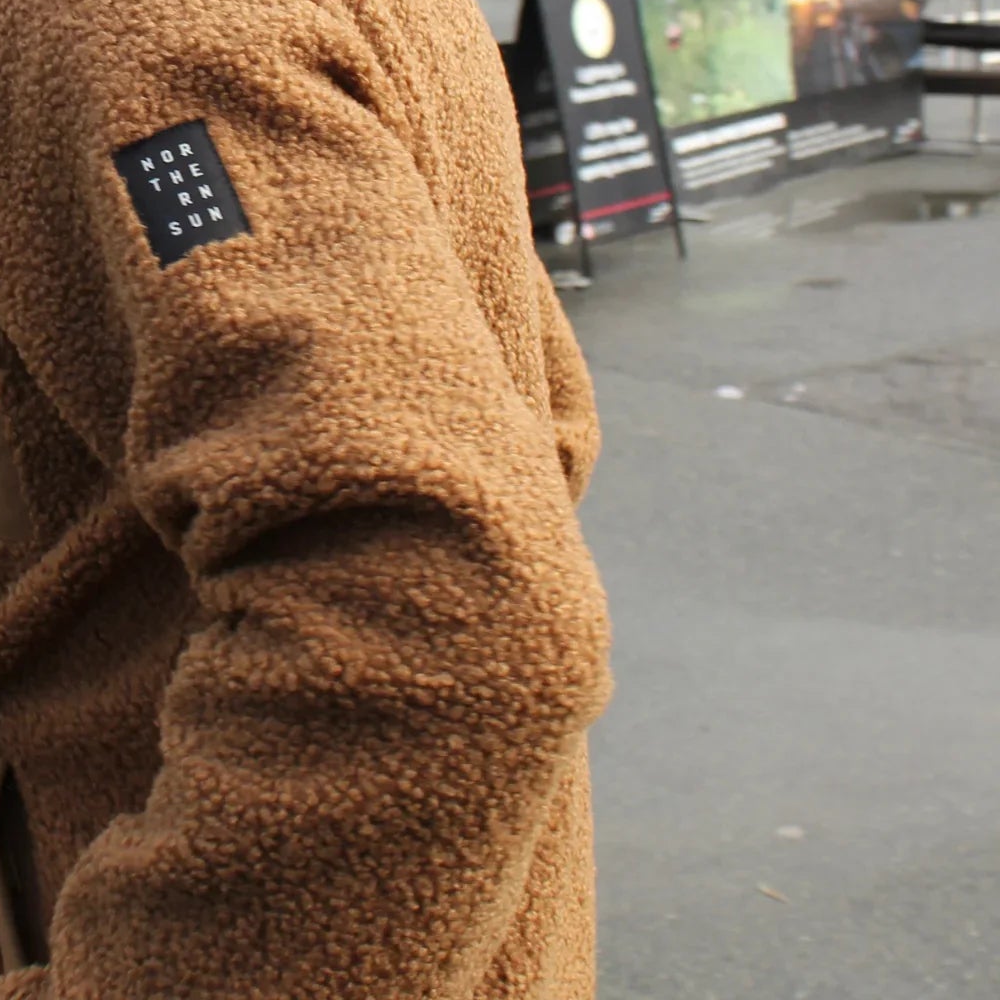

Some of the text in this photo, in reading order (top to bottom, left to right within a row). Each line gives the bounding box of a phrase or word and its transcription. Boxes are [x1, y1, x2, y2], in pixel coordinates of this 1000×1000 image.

[140, 143, 194, 172] NOR
[149, 163, 204, 192] THE
[177, 184, 213, 206] RN
[168, 206, 224, 236] SUN
